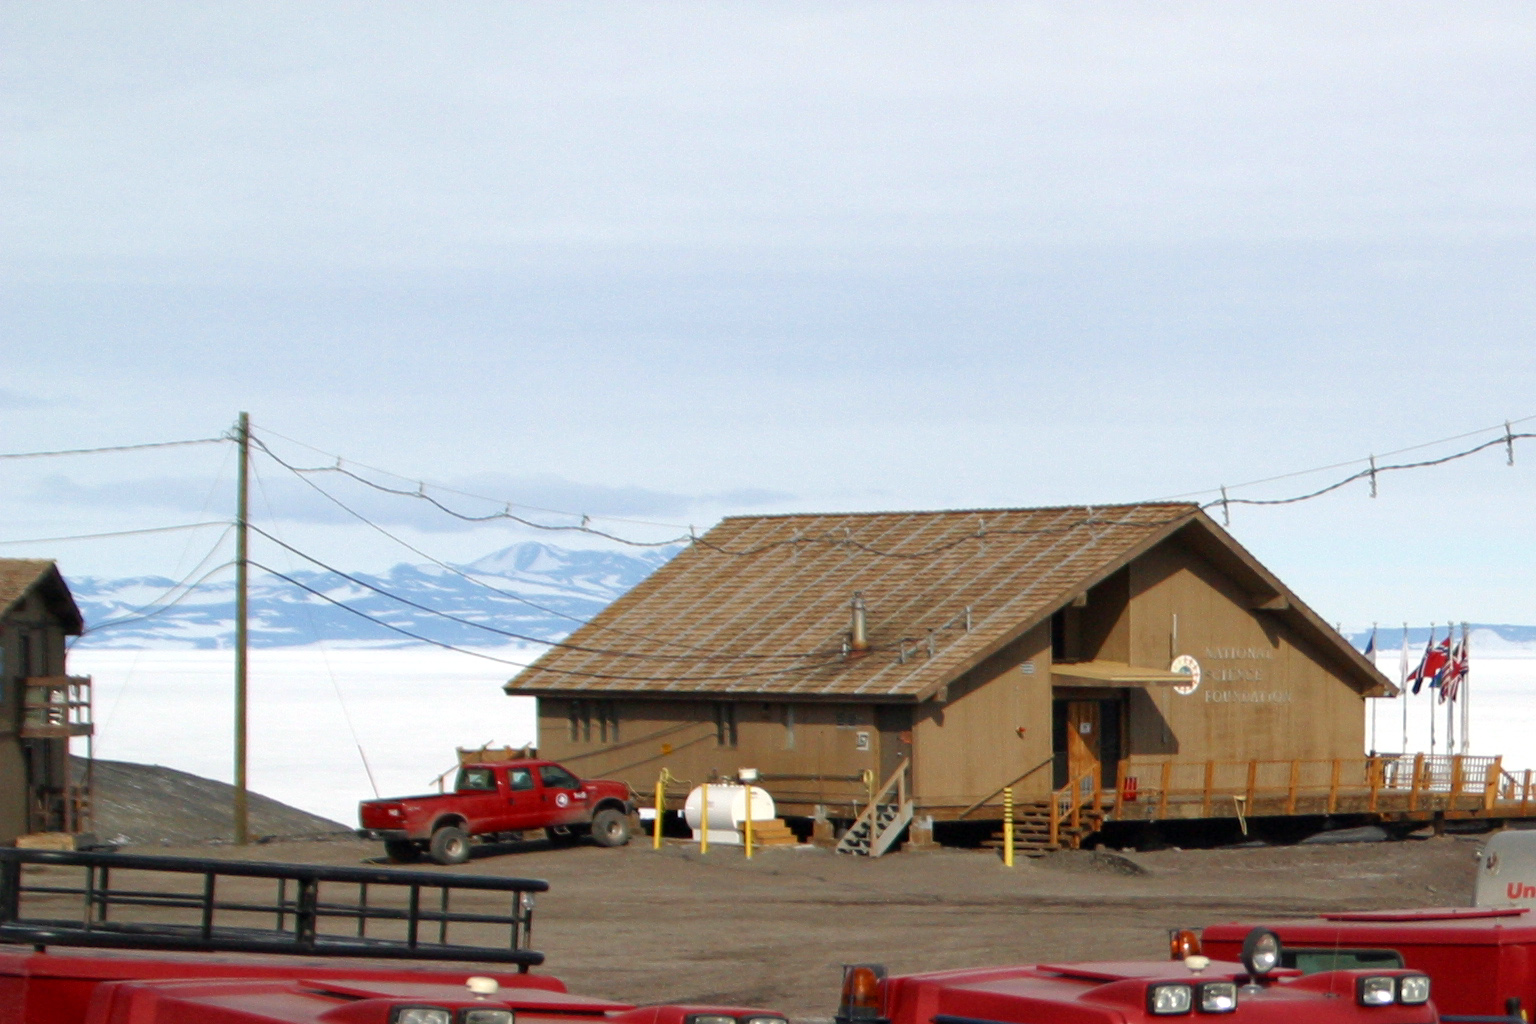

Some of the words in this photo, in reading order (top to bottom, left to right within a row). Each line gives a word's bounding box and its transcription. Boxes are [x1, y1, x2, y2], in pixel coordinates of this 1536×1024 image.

[1205, 647, 1274, 660] NATIONAL
[1205, 668, 1262, 681] SCIENCE
[1205, 690, 1292, 703] FOUNDATION
